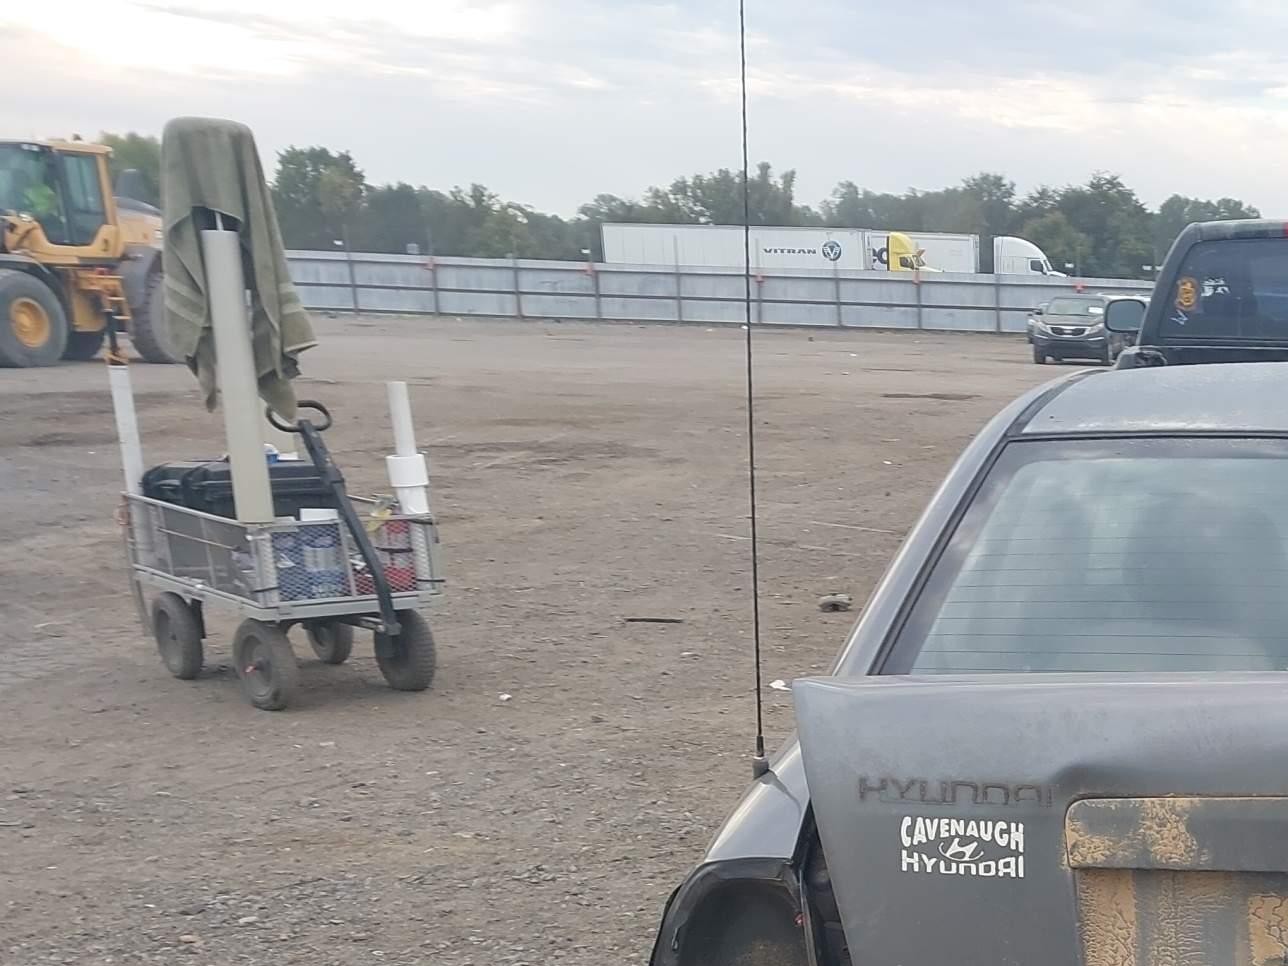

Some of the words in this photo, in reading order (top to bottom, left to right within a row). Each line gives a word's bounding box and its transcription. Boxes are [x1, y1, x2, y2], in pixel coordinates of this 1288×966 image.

[763, 247, 817, 255] VITRAN
[858, 777, 1053, 806] HYUNDAI
[900, 816, 1025, 853] CAVENAUGH
[901, 849, 1025, 878] HYUNDAI
